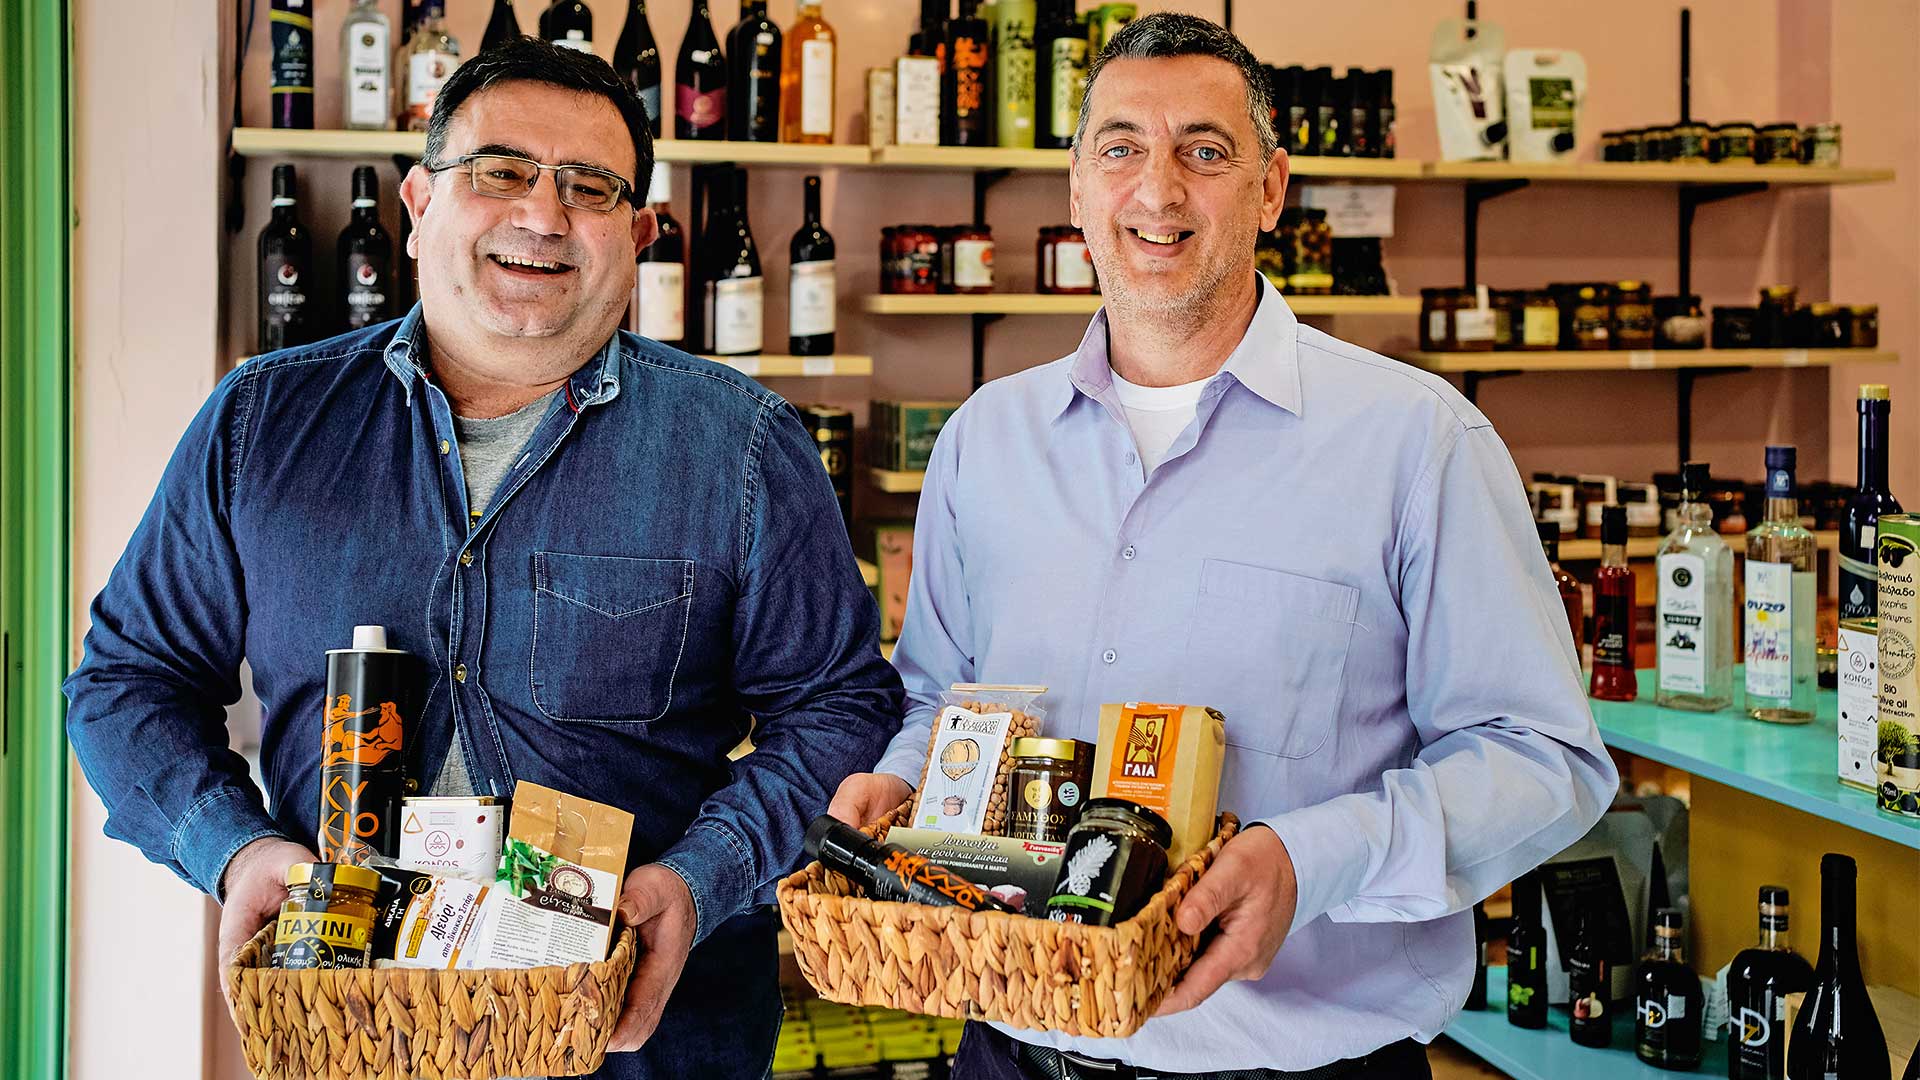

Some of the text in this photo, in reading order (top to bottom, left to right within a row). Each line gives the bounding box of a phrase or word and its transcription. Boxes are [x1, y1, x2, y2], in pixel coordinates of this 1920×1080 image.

[1896, 699, 1908, 709] oil
[1124, 763, 1156, 777] ΓΑΙΑ
[916, 847, 930, 857] με
[957, 852, 973, 861] και
[384, 898, 401, 928] ΔΙΚΑΙΑ
[282, 918, 353, 939] TAXINI
